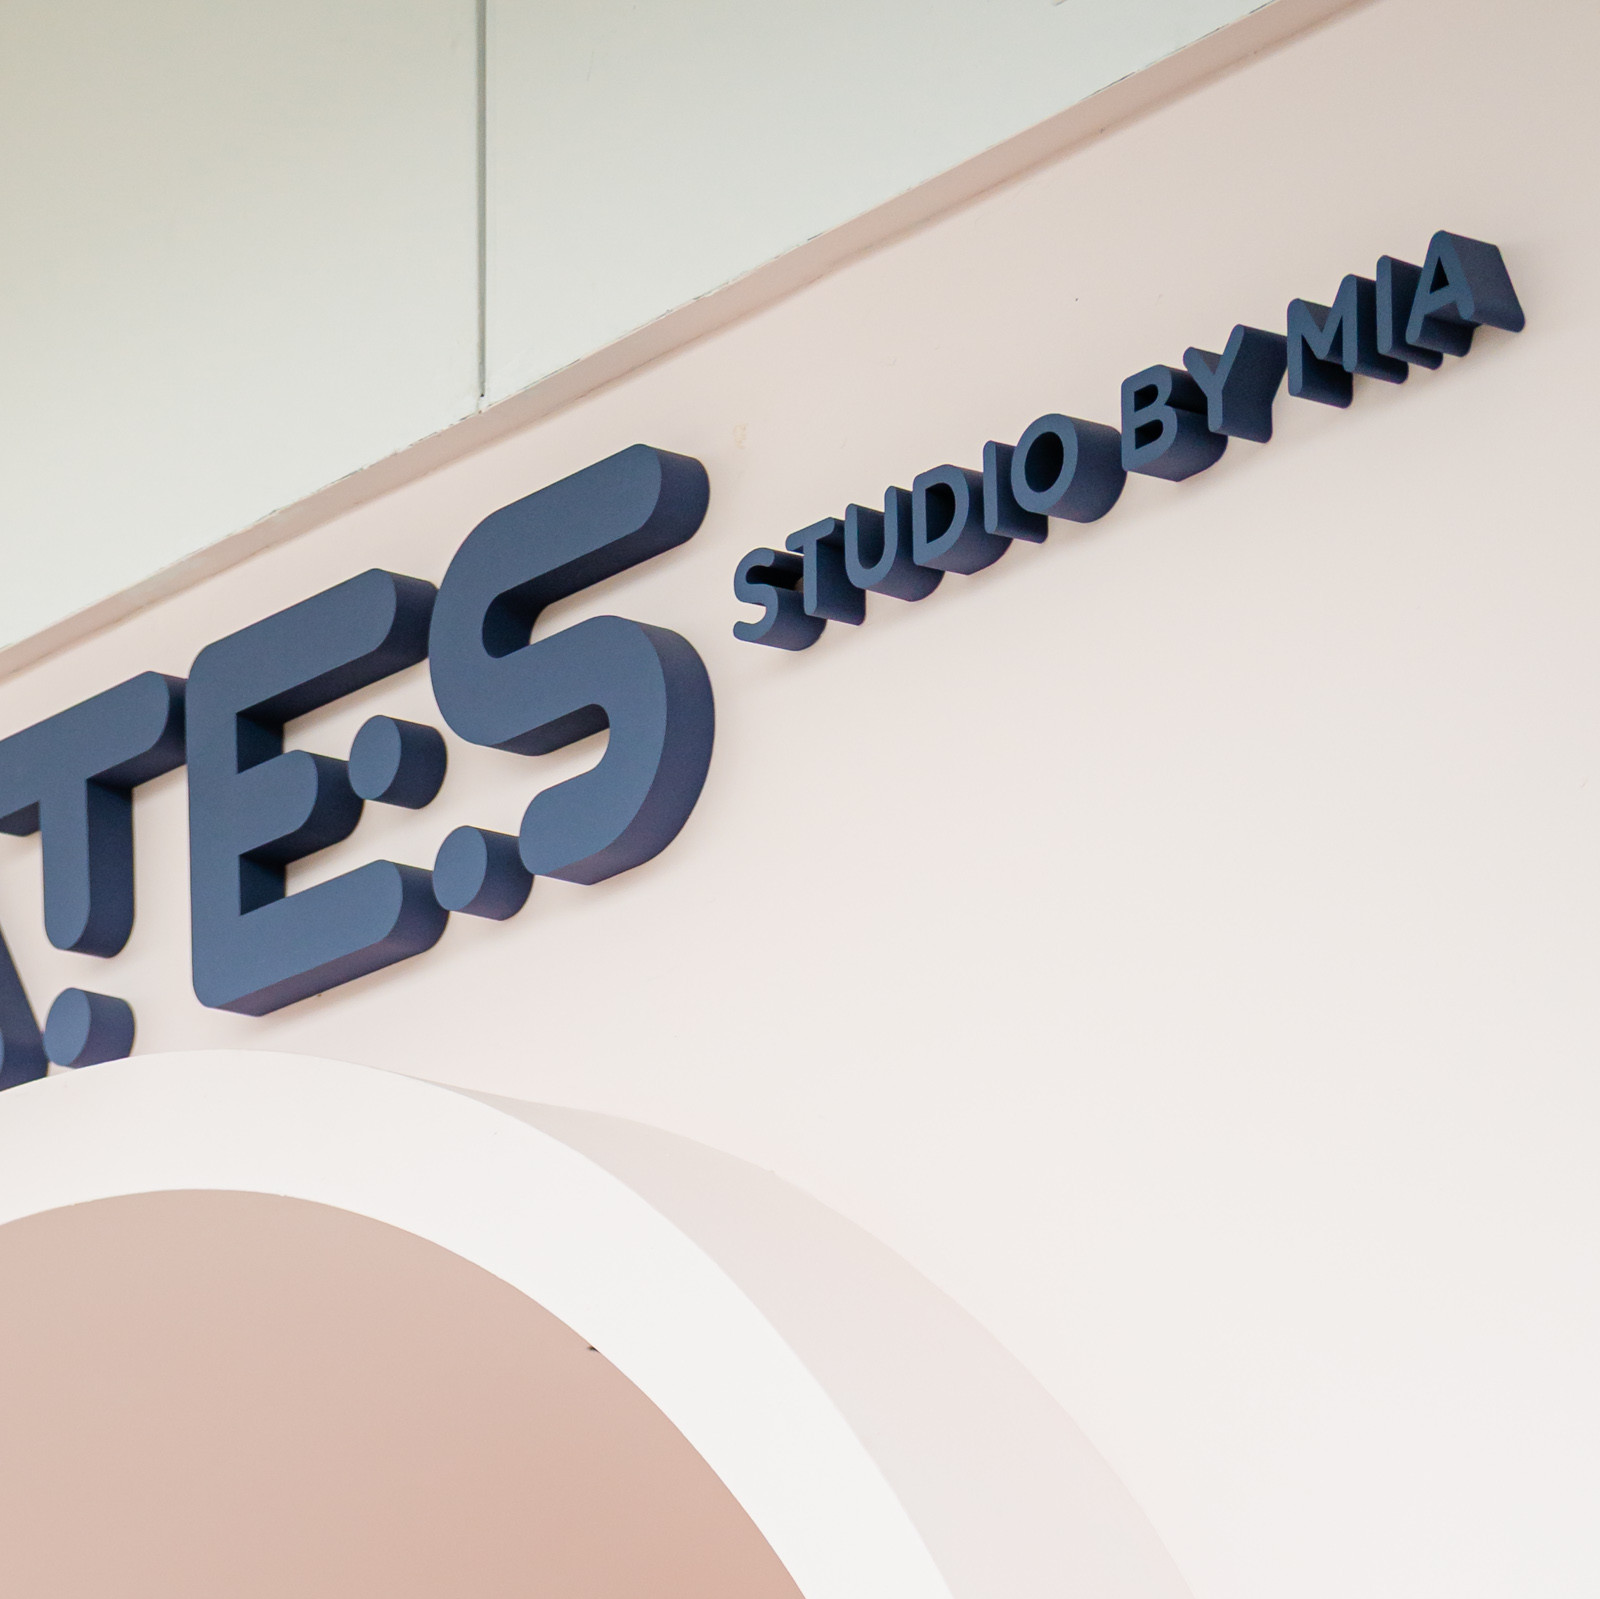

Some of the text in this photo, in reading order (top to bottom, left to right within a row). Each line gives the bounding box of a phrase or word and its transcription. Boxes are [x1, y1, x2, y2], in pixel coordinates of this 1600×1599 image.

[732, 412, 1128, 652] STUDIO
[1120, 323, 1289, 483] BY
[1286, 229, 1526, 410] MIA
